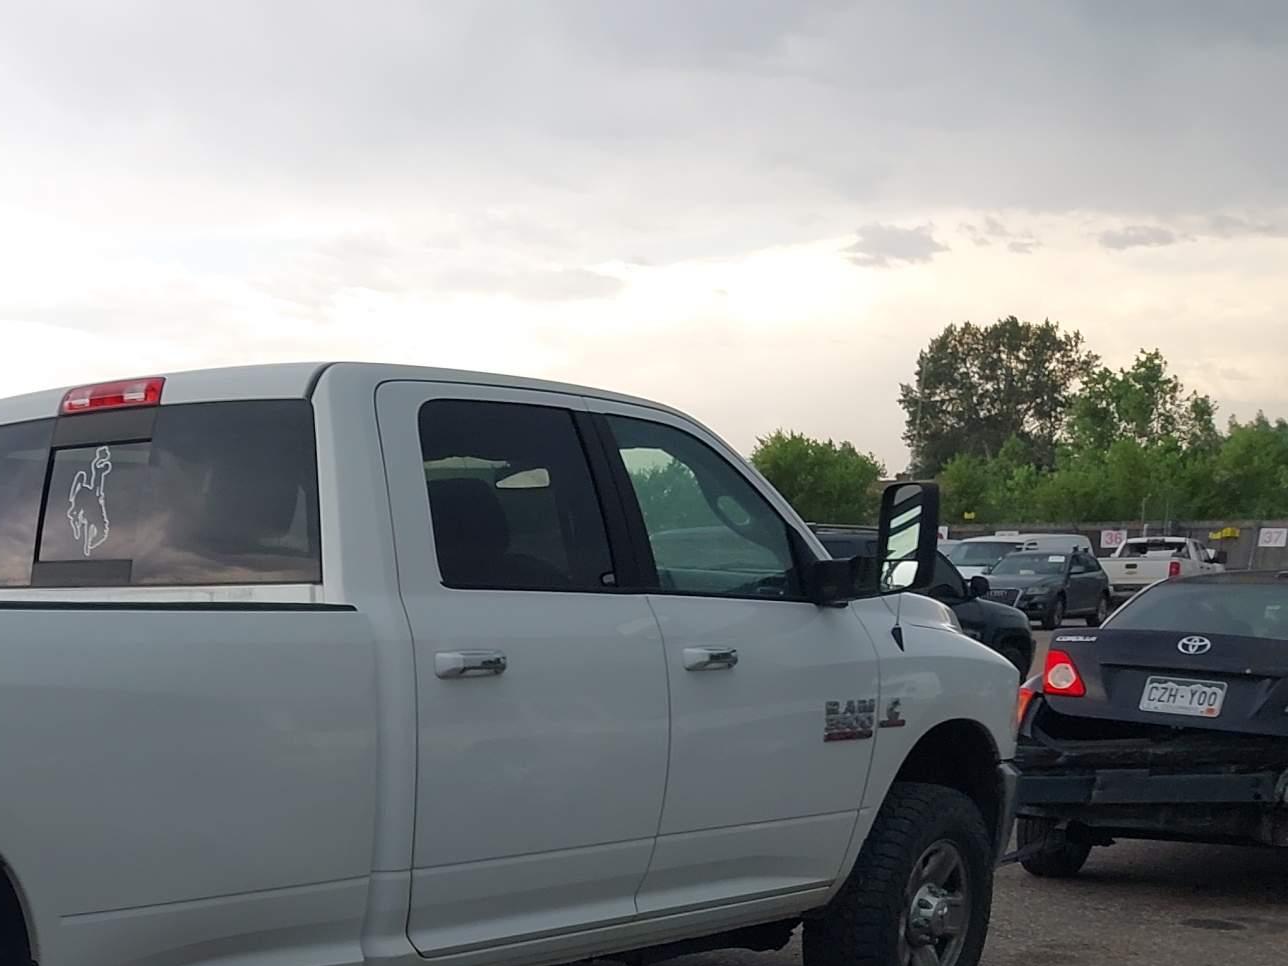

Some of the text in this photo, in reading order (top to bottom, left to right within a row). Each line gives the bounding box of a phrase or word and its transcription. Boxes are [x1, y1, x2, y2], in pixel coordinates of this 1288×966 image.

[1105, 532, 1123, 545] 36
[1263, 531, 1282, 545] 37
[825, 699, 875, 715] RAM
